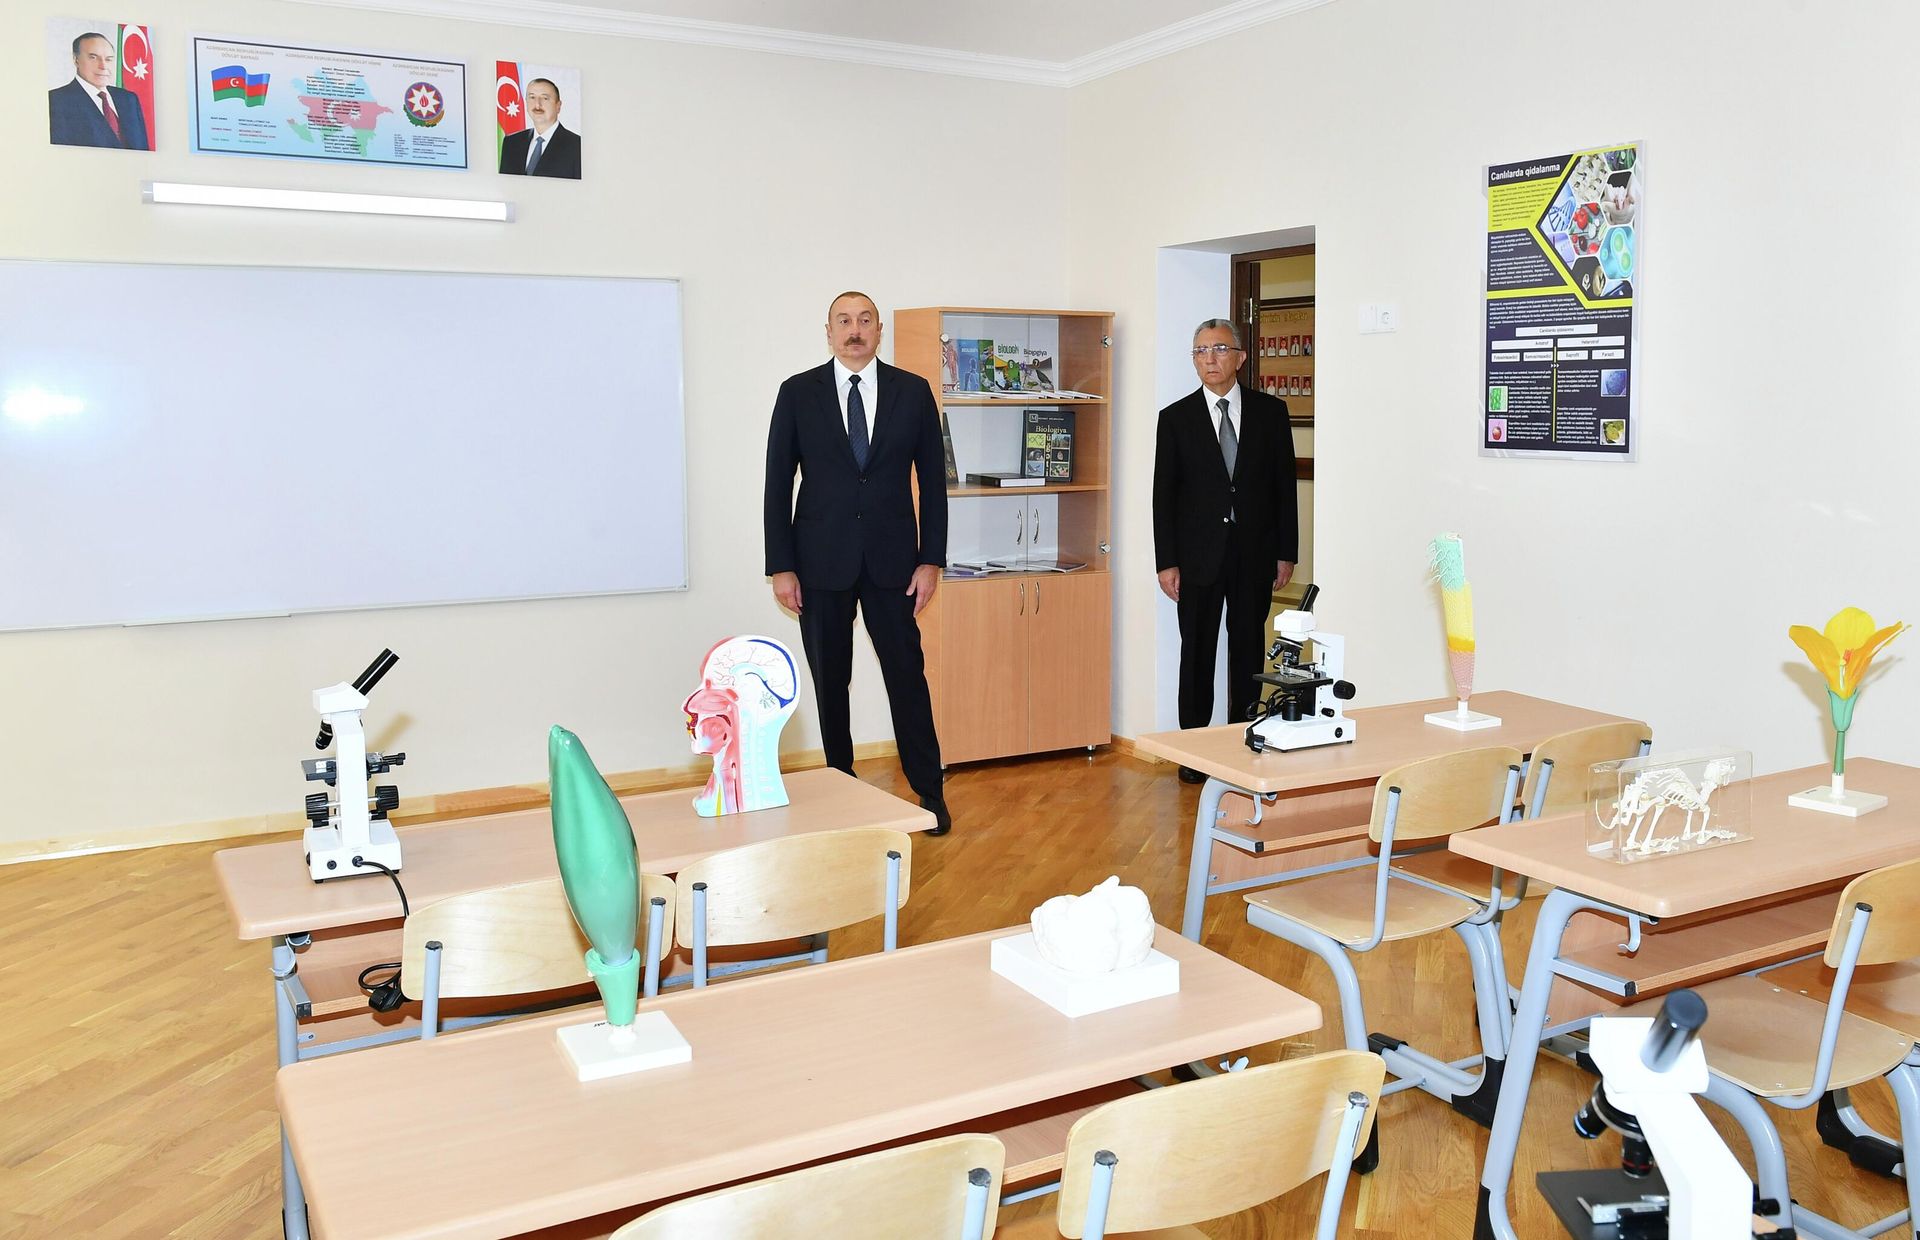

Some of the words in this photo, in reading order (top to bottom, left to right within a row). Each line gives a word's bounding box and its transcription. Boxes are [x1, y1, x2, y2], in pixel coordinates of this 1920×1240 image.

[1490, 168, 1524, 181] Canlılarda
[1524, 163, 1561, 178] qidalanma
[1035, 424, 1067, 434] Biologiya
